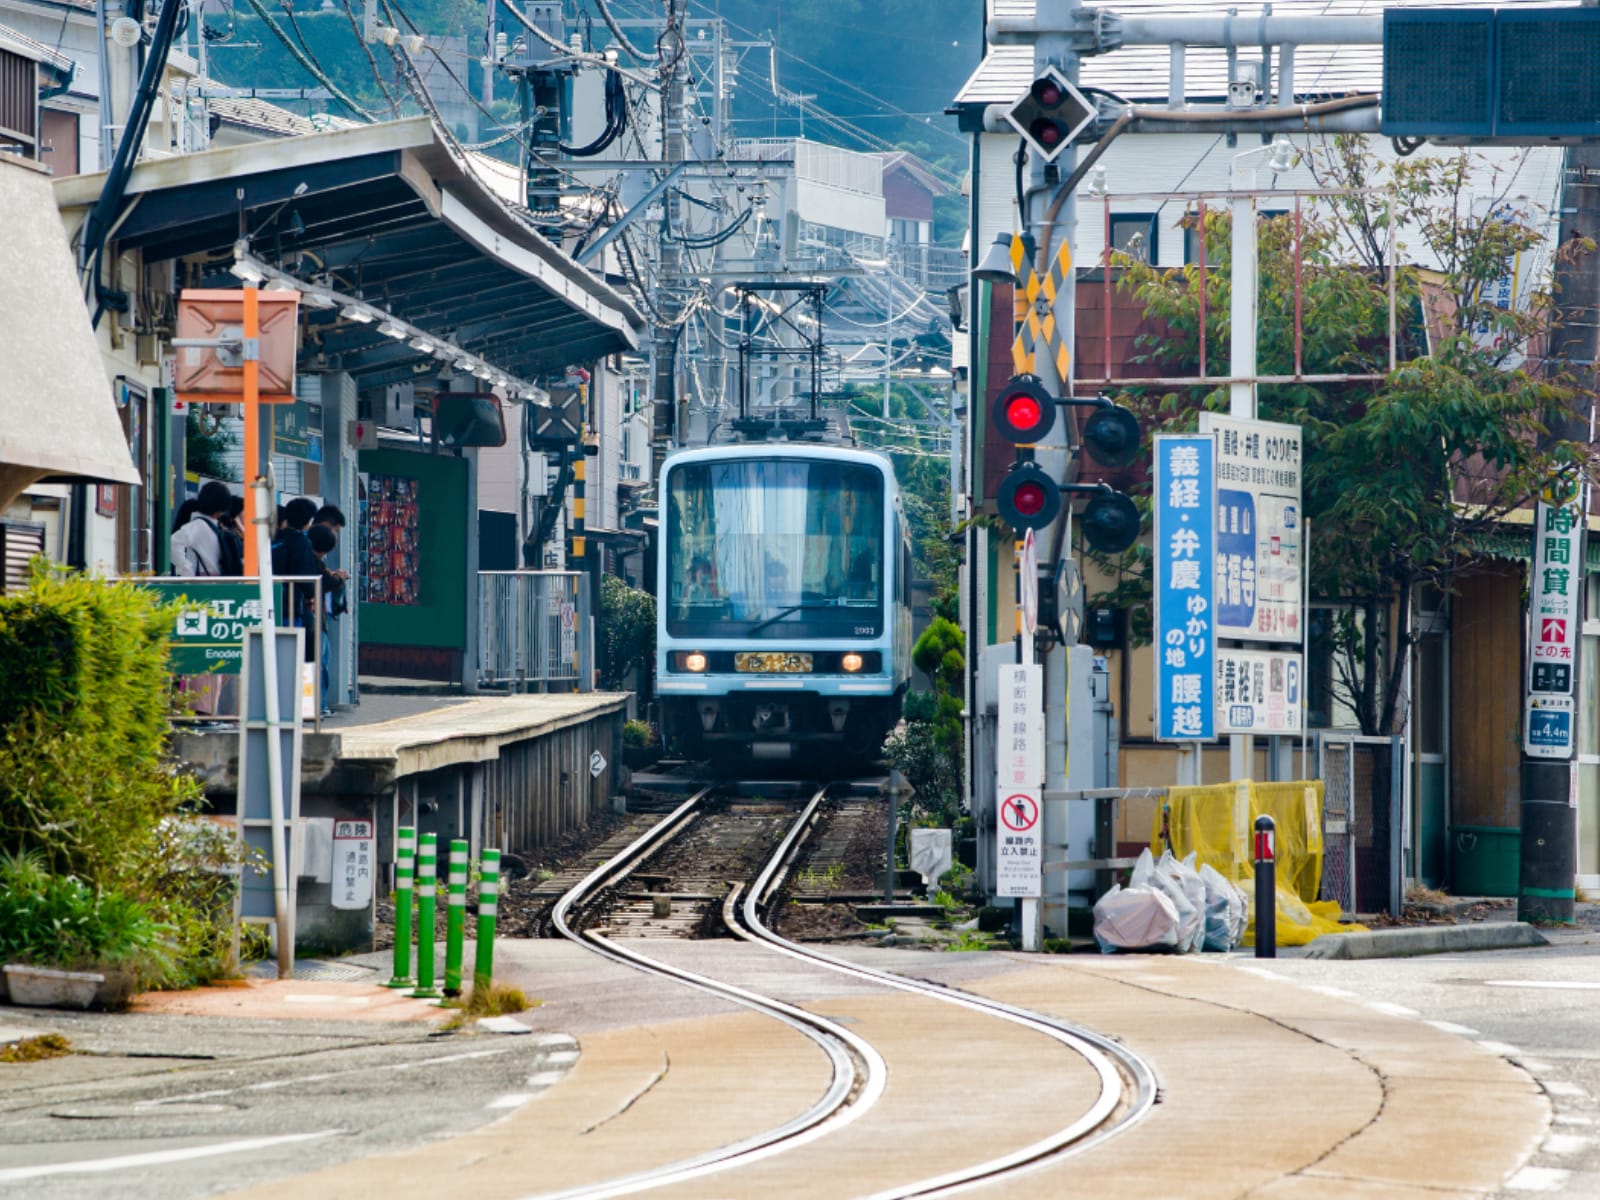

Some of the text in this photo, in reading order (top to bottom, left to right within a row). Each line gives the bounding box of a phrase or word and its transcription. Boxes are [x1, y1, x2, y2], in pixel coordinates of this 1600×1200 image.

[1169, 446, 1201, 589] 義経・弁慶
[1542, 506, 1572, 596] 時間貸
[1186, 594, 1207, 659] ゆかり
[205, 648, 242, 660] Enoden
[1165, 628, 1186, 668] の地
[1535, 645, 1571, 659] この先
[1171, 674, 1203, 736] 腰越
[1542, 722, 1569, 737] 4.4m
[591, 753, 602, 772] 2
